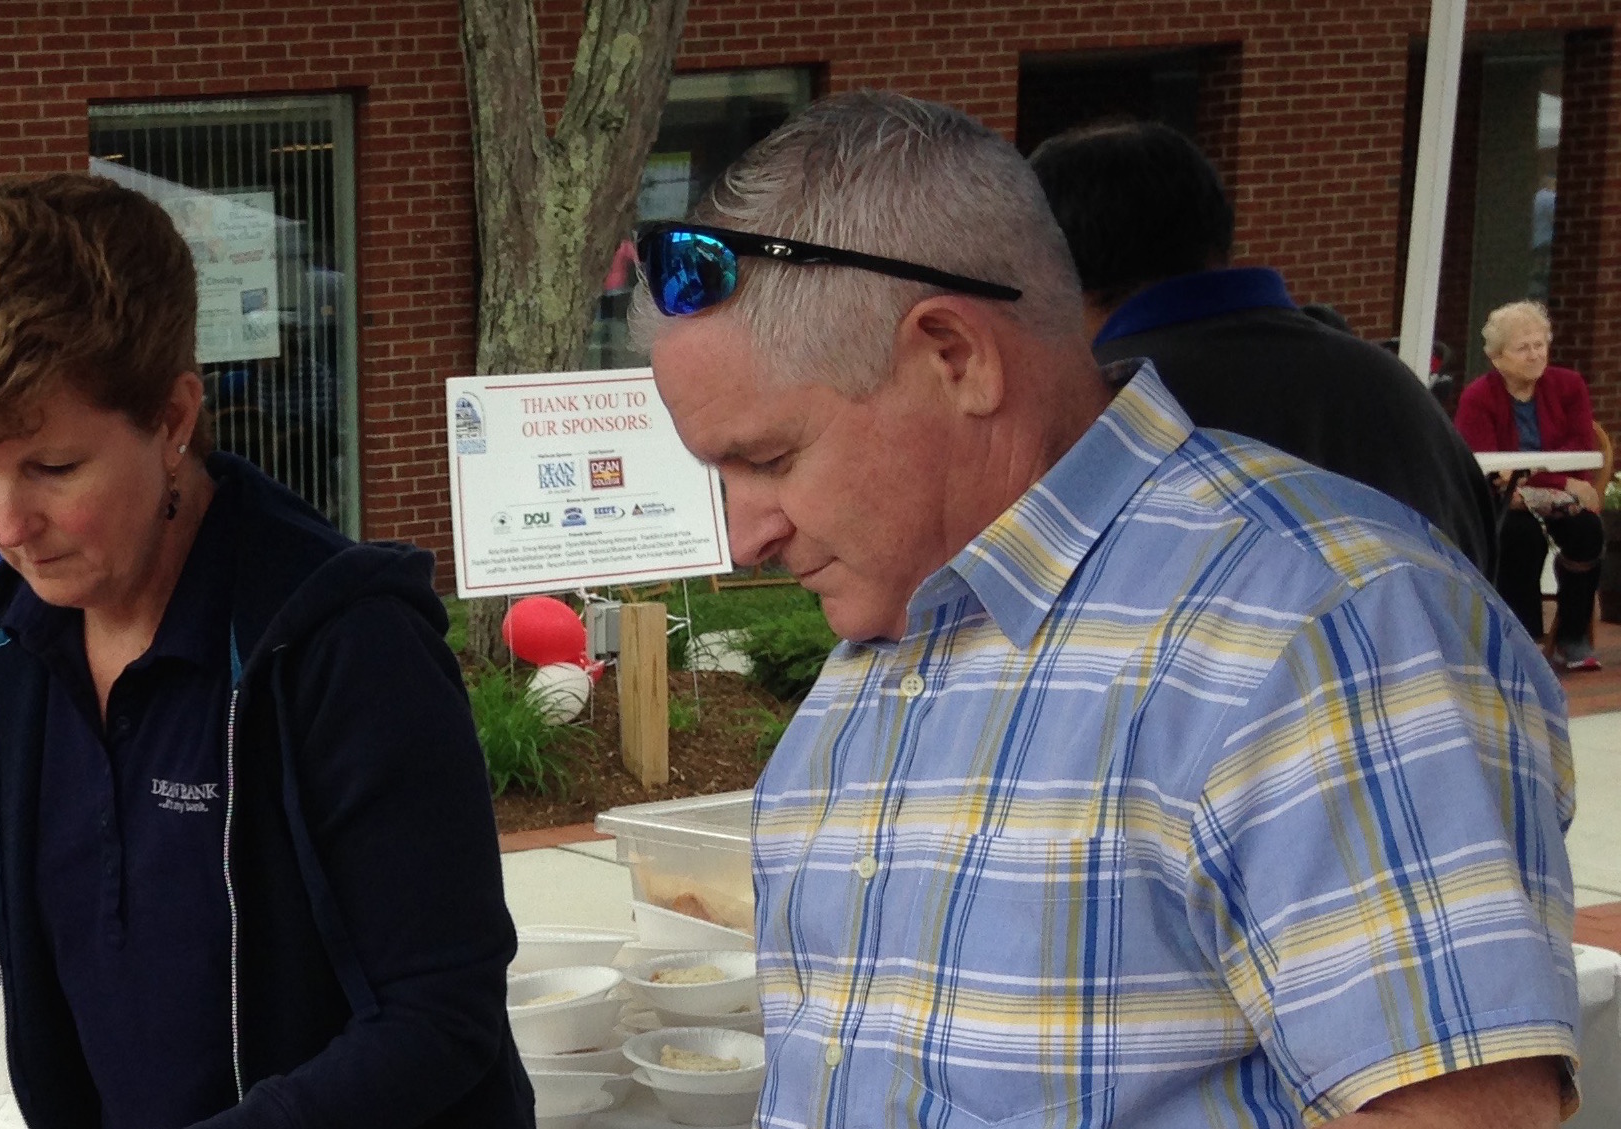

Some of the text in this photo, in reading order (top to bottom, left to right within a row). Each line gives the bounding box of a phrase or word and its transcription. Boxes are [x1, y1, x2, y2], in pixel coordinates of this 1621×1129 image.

[521, 391, 647, 414] THANK YOU TO
[522, 414, 653, 438] OUR SPONSORS:
[539, 461, 574, 475] DEAN
[591, 460, 619, 473] DEAN
[540, 473, 576, 489] BANK
[524, 511, 550, 526] DCU
[151, 779, 220, 800] DEAN BANK
